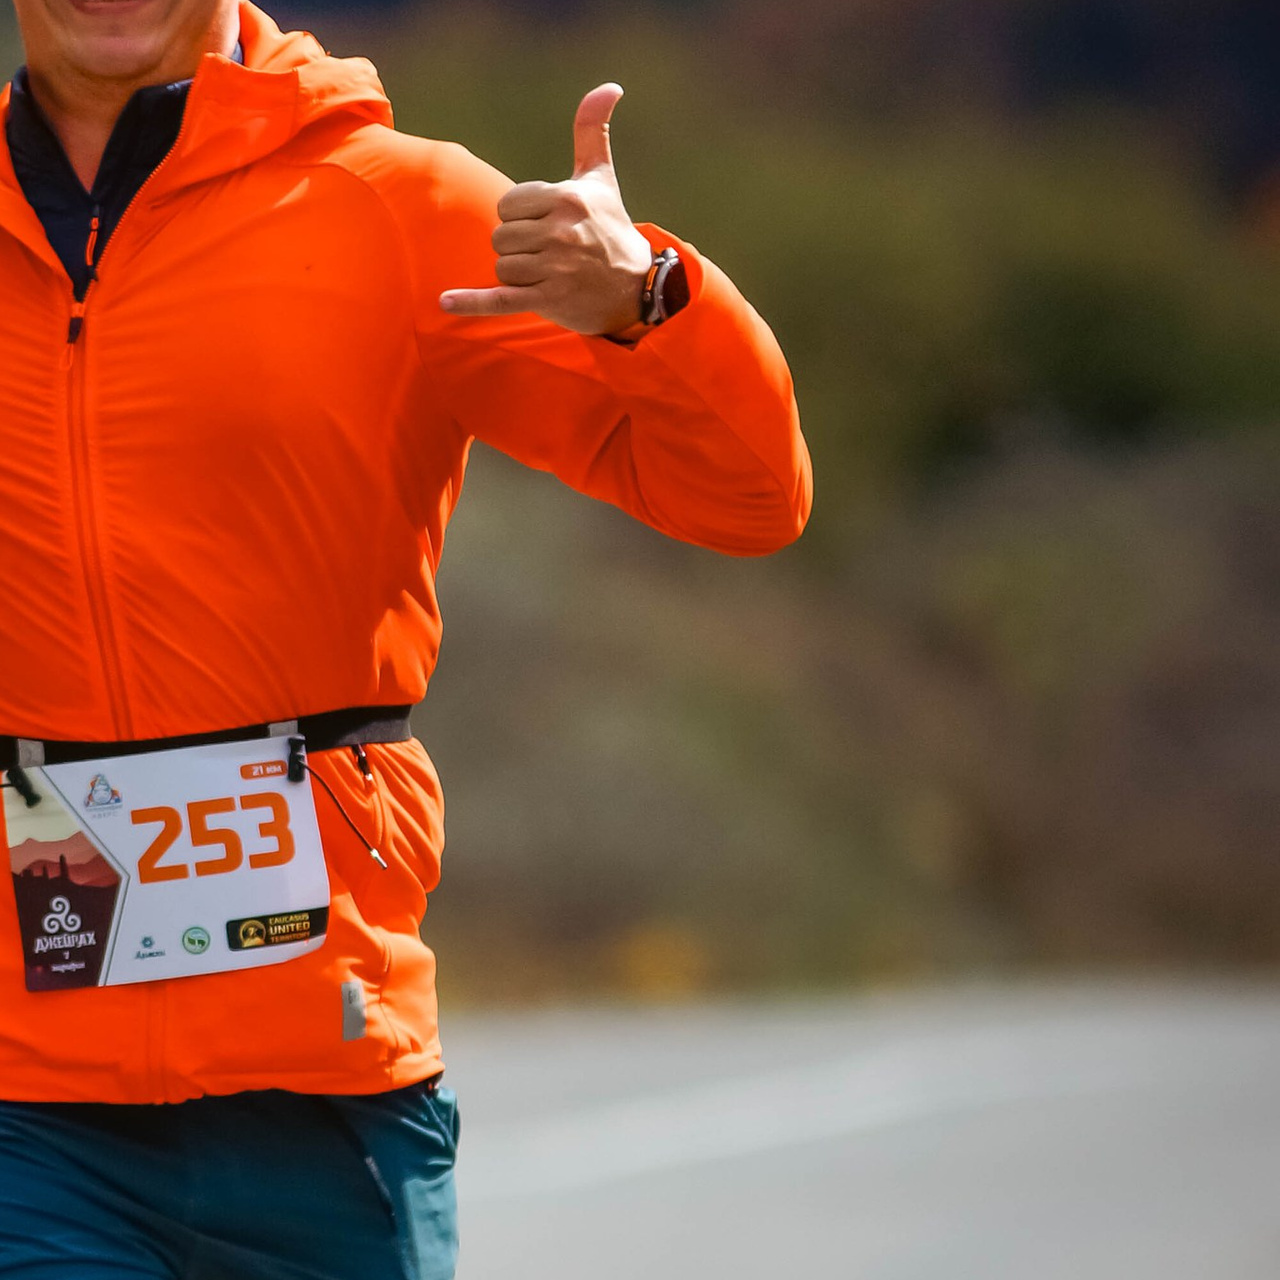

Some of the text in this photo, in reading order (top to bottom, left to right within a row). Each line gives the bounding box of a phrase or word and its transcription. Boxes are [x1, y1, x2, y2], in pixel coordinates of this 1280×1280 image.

[252, 764, 264, 776] 21
[130, 791, 296, 884] 253
[270, 913, 310, 925] CAUCASUS
[270, 921, 311, 935] UNITED
